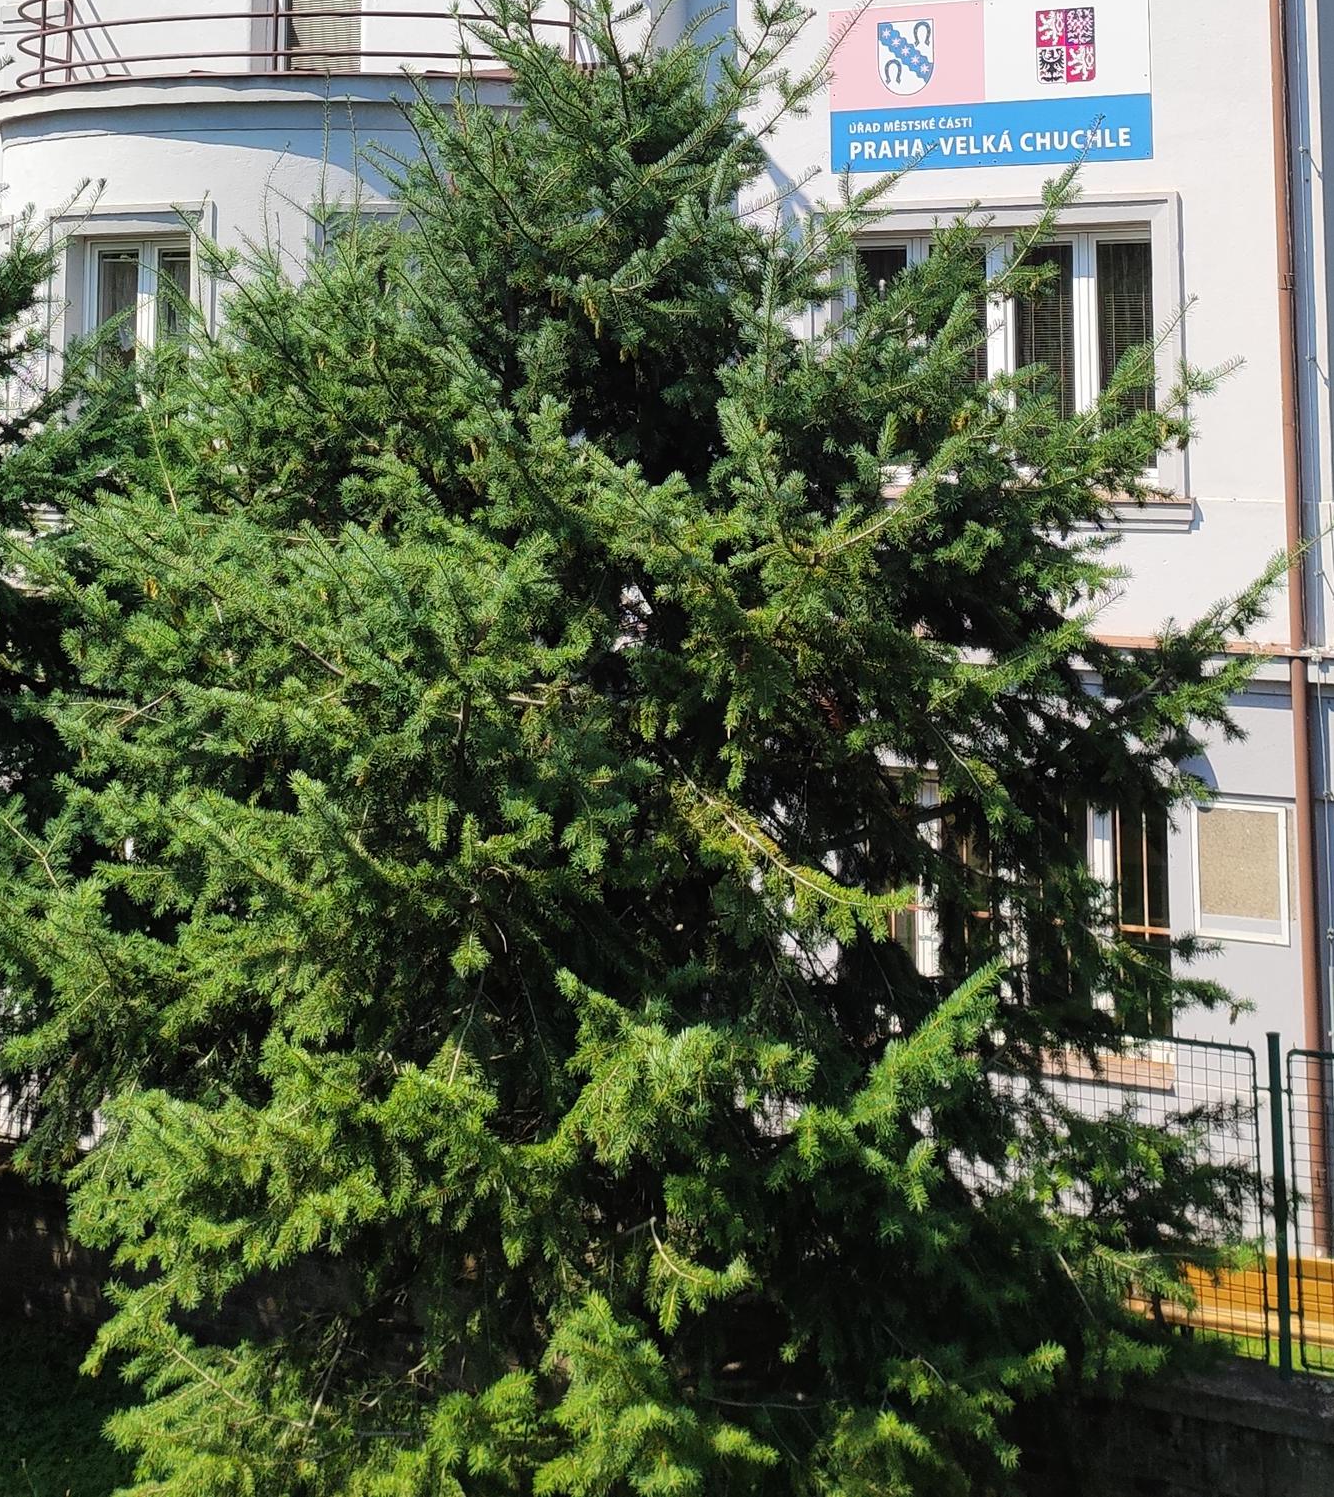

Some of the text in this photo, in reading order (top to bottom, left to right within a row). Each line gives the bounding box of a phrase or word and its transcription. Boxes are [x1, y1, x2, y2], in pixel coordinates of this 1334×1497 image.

[849, 116, 972, 134] ÚŘAD MĚSTSKÉ ČÁSTI
[850, 127, 1131, 160] PRAHA VELKÁ CHUCHLE
